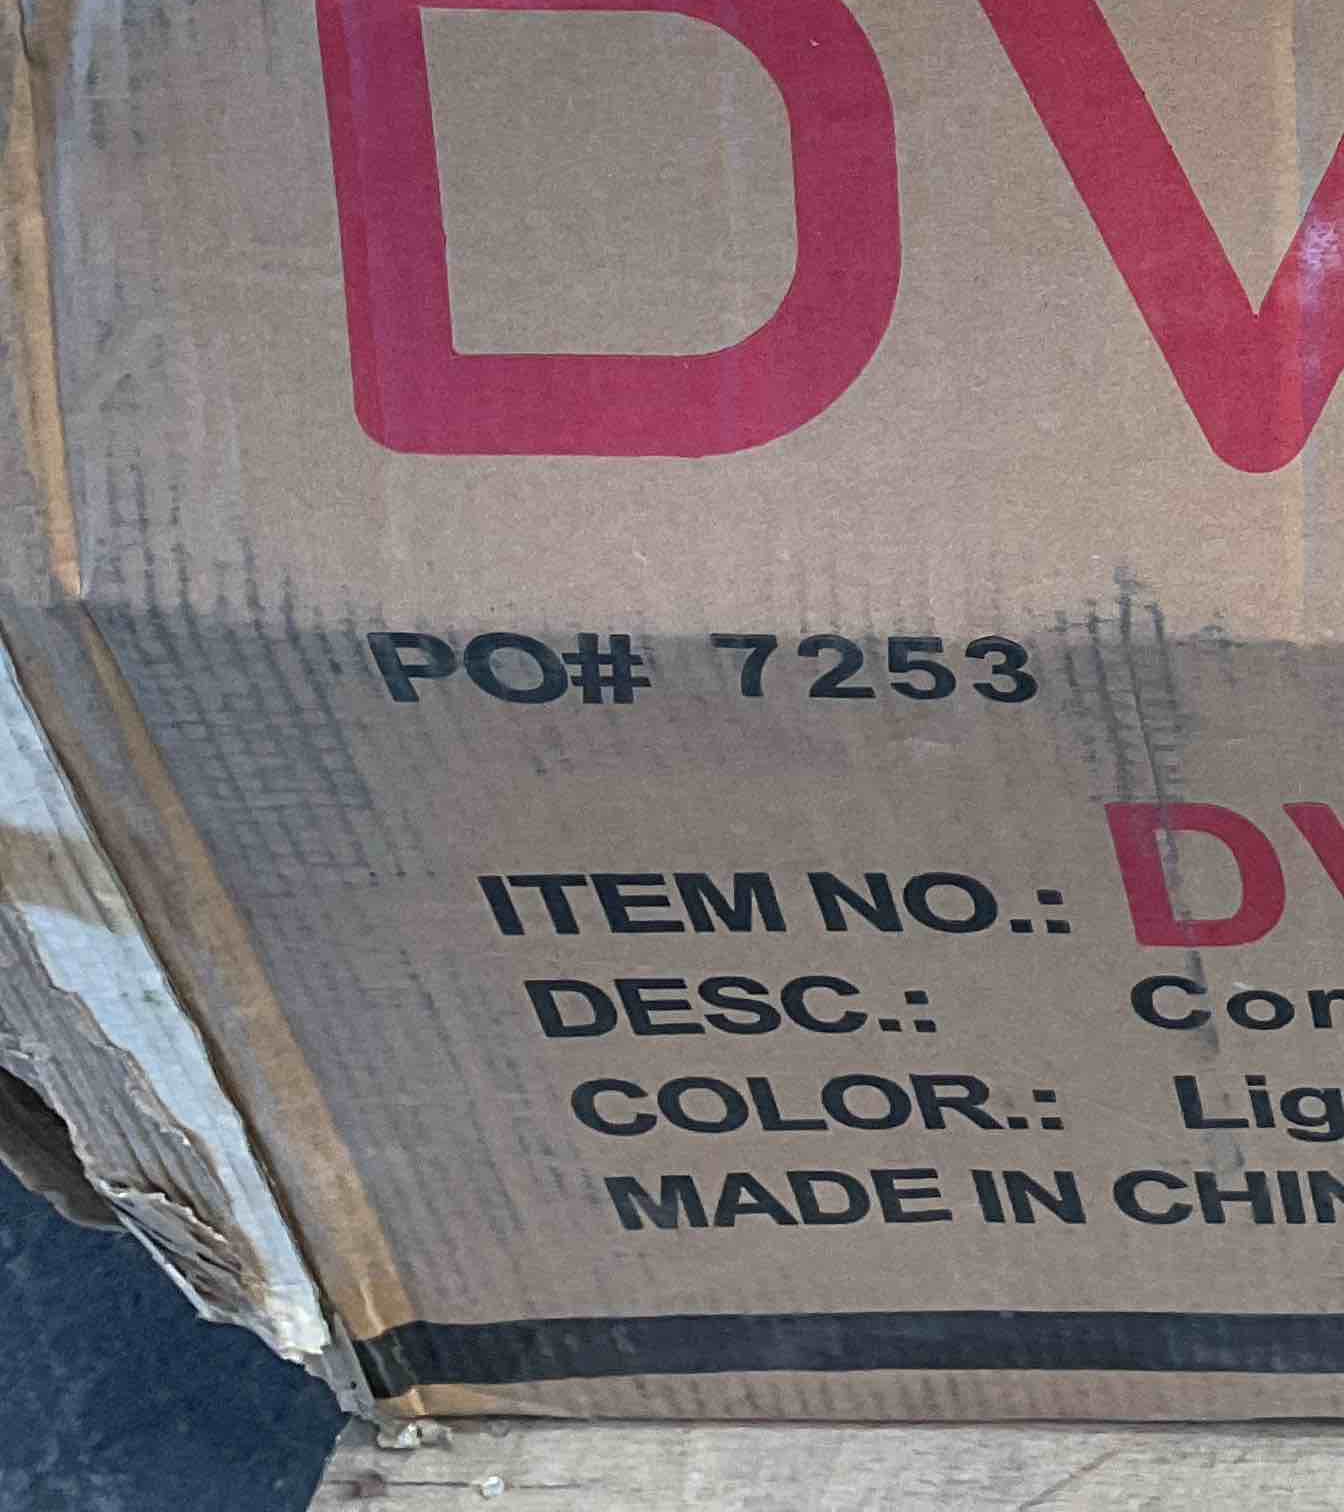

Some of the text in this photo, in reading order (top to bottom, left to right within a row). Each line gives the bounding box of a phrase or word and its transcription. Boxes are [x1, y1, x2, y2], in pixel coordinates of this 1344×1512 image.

[367, 631, 1039, 705] PO# 7253
[478, 872, 787, 936] ITEM
[808, 871, 1071, 934] NO.:
[524, 975, 937, 1038] DESC.:
[570, 1073, 1065, 1137] COLOR.:
[603, 1168, 953, 1231] MADE
[971, 1169, 1087, 1224] IN
